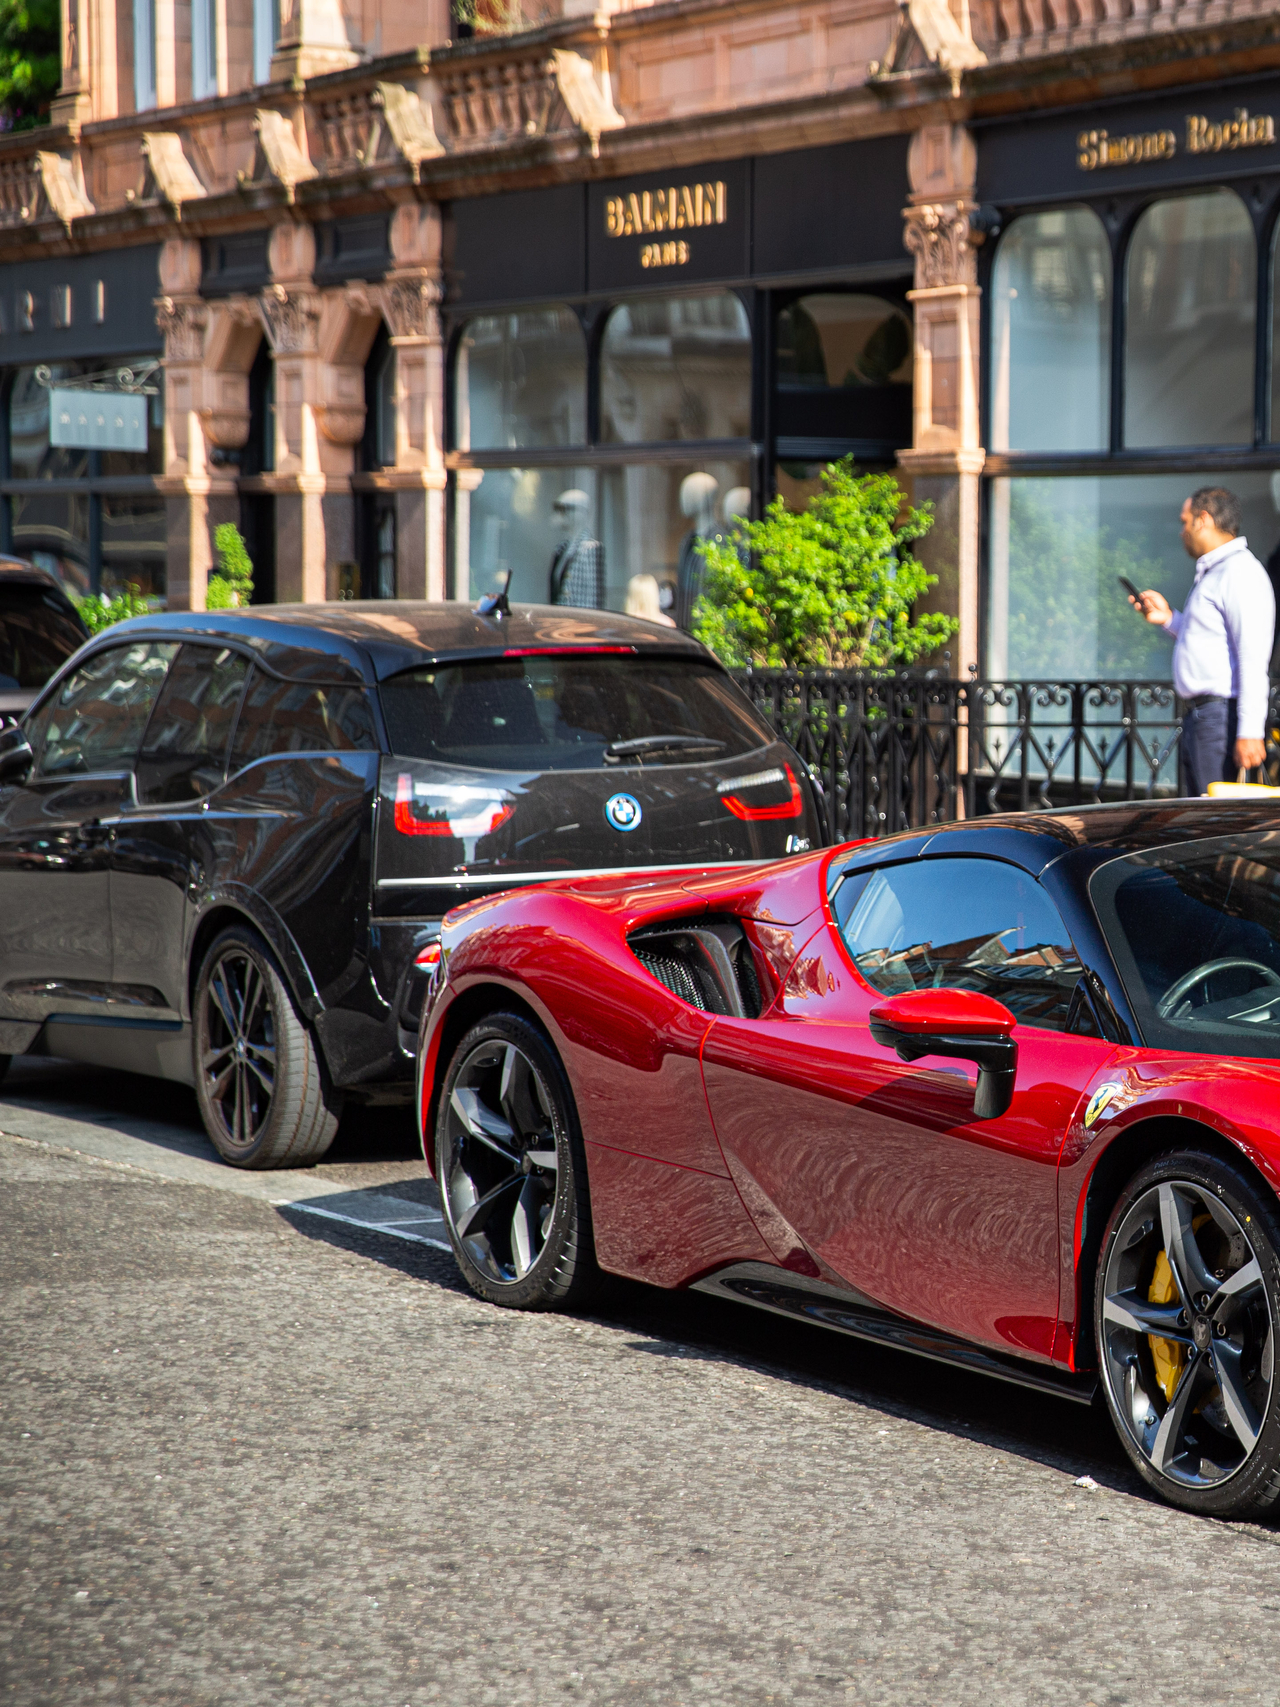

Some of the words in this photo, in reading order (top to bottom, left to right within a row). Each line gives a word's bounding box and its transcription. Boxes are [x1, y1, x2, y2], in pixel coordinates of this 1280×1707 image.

[1077, 128, 1176, 171] Simone
[1185, 107, 1277, 154] Rocha
[605, 180, 727, 238] BALMAIN
